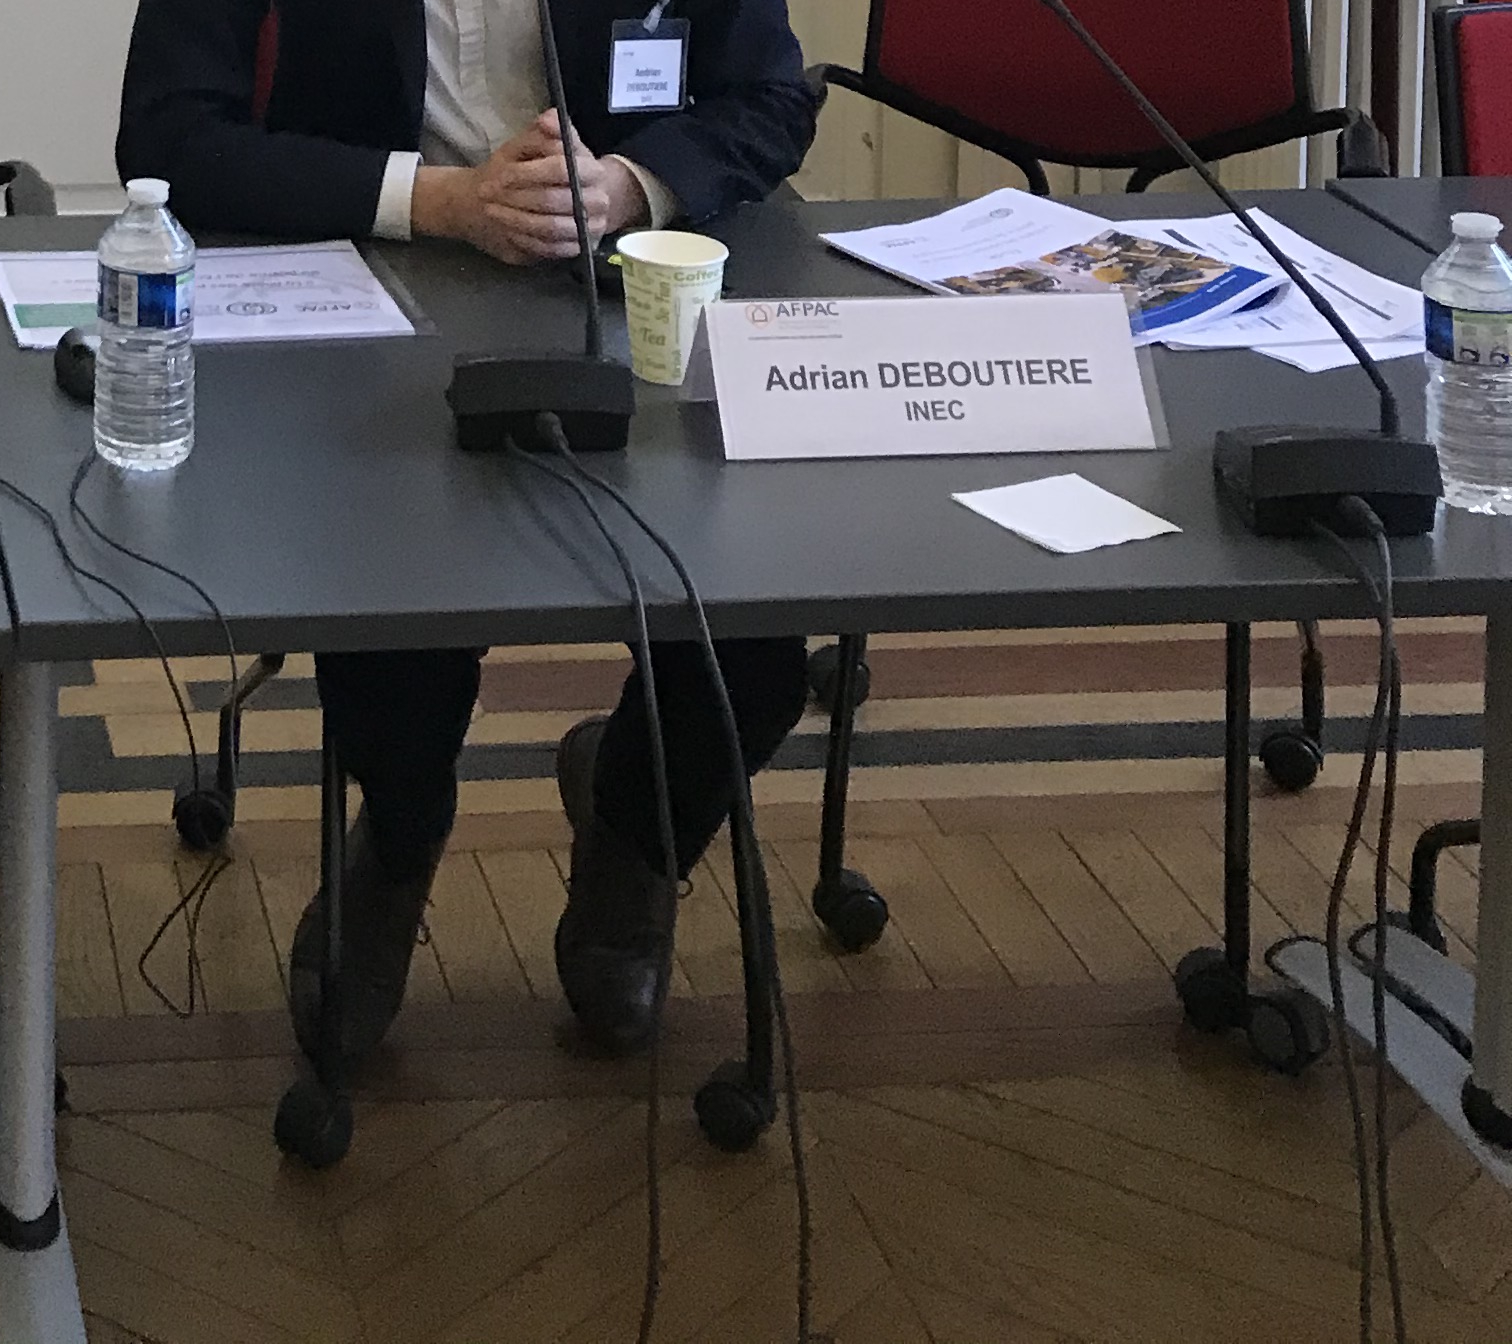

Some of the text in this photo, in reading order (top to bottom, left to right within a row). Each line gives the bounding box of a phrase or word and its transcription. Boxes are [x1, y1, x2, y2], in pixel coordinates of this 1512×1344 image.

[776, 301, 839, 318] AFPAC
[765, 358, 1093, 392] Adrian DEBOUTIERE
[904, 400, 966, 422] INEC
